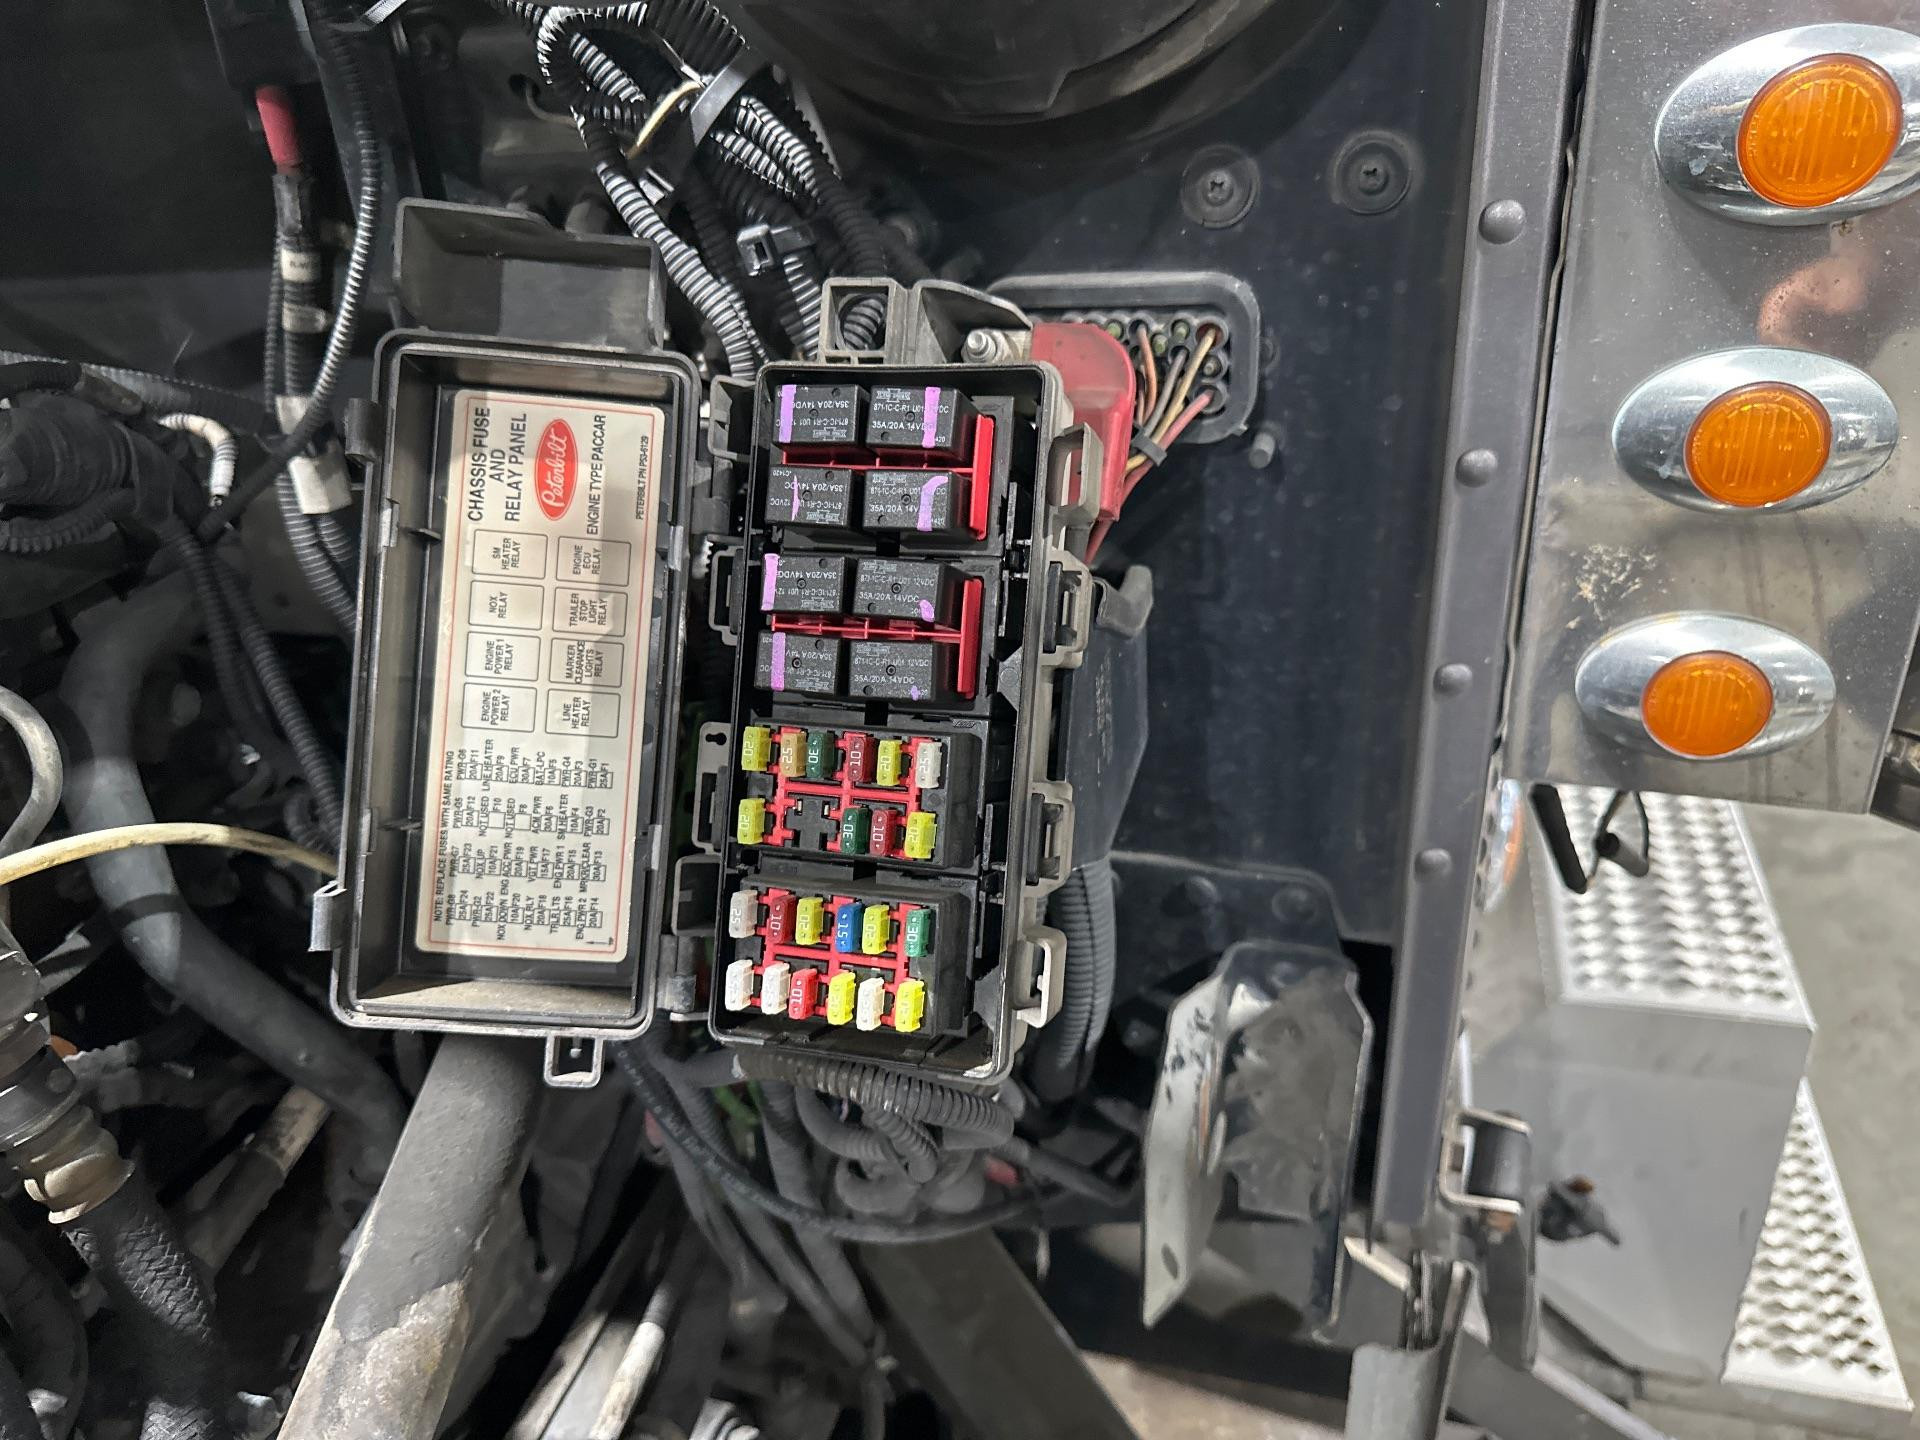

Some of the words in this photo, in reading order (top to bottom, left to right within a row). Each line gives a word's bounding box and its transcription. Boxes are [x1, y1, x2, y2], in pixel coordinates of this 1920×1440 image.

[473, 408, 490, 448] FUSE
[509, 413, 526, 465] PANEL
[592, 415, 605, 461] PACCAR
[489, 449, 505, 483] AND
[541, 428, 567, 506] Peterbilt
[590, 464, 602, 491] TYPE
[468, 453, 487, 521] CHASSIS
[505, 469, 523, 521] RELAY
[587, 494, 600, 535] ENGINE
[493, 547, 501, 559] SM
[502, 538, 512, 570] HEATER
[511, 541, 521, 568] RELAY
[573, 545, 583, 575] ENGINE
[583, 552, 592, 569] ECU
[592, 548, 601, 575] RELAY
[489, 596, 498, 613] NOX
[498, 592, 508, 619] RELAY
[569, 593, 579, 626] TRAILER
[579, 600, 587, 621] STOP
[588, 600, 598, 623] LIGHT
[598, 598, 608, 625] RELAY
[485, 641, 495, 671] ENGINE
[494, 644, 504, 674] POWER
[504, 643, 513, 670] RELAY
[566, 645, 576, 678] MARKER
[575, 640, 585, 684] CLEARANCE
[585, 649, 594, 677] LIGHTS
[594, 650, 604, 677] RELAY
[481, 692, 491, 721] ENGINE
[491, 695, 500, 725] POWER
[500, 694, 510, 721] RELAY
[563, 704, 571, 721] LINE
[571, 697, 581, 729] HEATER
[581, 700, 591, 726] RELAY
[470, 750, 479, 763] F11
[484, 739, 493, 771] HEATER
[496, 755, 505, 765] F9
[510, 747, 520, 766] PWR
[522, 757, 531, 767] F7
[548, 759, 557, 768] F5
[444, 751, 454, 781] RATING
[456, 749, 466, 780] PWR-G6
[469, 764, 478, 779] 20A
[535, 752, 546, 786] BAT-LPC
[562, 756, 571, 787] PWR-G4
[575, 760, 583, 770] F3
[601, 763, 609, 772] F1
[482, 773, 491, 791] LINE
[495, 766, 504, 781] 20A
[509, 768, 518, 783] ECU
[521, 768, 530, 783] 30A
[547, 769, 556, 783] 10A
[573, 771, 583, 786] 20A
[588, 758, 597, 789] PWR-G1
[599, 773, 608, 788] 25A
[443, 783, 452, 806] SAME
[467, 796, 475, 809] F12
[453, 797, 463, 829] PWR-G5
[480, 796, 489, 818] USED
[492, 798, 501, 811] F10
[506, 798, 515, 819] USED
[519, 804, 527, 814] F8
[533, 796, 542, 814] PWR
[545, 806, 553, 815] F6
[559, 794, 569, 826] HEATER
[571, 807, 580, 817] F4
[441, 808, 450, 828] WITH
[465, 810, 474, 825] 20A
[584, 806, 594, 837] PWR-G3
[597, 809, 606, 818] F2
[479, 818, 487, 837] NOT
[505, 821, 514, 838] NOT
[532, 816, 541, 834] ACM
[543, 816, 552, 831] 30A
[569, 818, 578, 832] 10A
[595, 820, 605, 834] 20A
[439, 830, 448, 856] FUSES
[558, 829, 566, 840] SM
[463, 843, 472, 857] F23
[477, 849, 485, 859] UP
[490, 845, 498, 859] F21
[503, 842, 512, 860] PWR
[515, 846, 524, 860] F19
[529, 846, 538, 864] PWR
[542, 848, 550, 861] F17
[568, 849, 577, 863] F15
[594, 851, 603, 865] F13
[449, 846, 459, 877] PWR-G7
[462, 859, 471, 873] 25A
[488, 860, 497, 874] 10A
[502, 861, 511, 878] ACC
[514, 862, 523, 876] 20A
[555, 852, 564, 870] PWR
[436, 858, 446, 895] REPLACE
[476, 861, 485, 879] NOX
[528, 865, 537, 882] VGT
[540, 864, 550, 877] 15A
[567, 865, 576, 878] 20A
[593, 866, 602, 881] 30A
[501, 879, 510, 895] ENG
[554, 872, 563, 888] ENG
[460, 890, 469, 904] F24
[486, 891, 494, 905] F22
[512, 893, 521, 907] F20
[525, 896, 534, 912] RLY
[538, 895, 547, 908] F18
[552, 896, 561, 911] LTS
[564, 896, 573, 910] F16
[590, 897, 599, 912] F14
[434, 897, 444, 921] NOTE:
[445, 894, 456, 925] PWR-G8
[459, 905, 468, 919] 25A
[472, 896, 482, 927] PWR-G2
[485, 907, 494, 921] 25A
[498, 899, 508, 923] DOWN
[511, 909, 520, 922] 10A
[537, 910, 546, 924] 20A
[578, 904, 587, 921] PWR
[524, 914, 533, 930] NOX
[551, 913, 560, 933] TRLR
[563, 911, 572, 926] 25A
[589, 913, 598, 927] 20A
[497, 924, 506, 940] NOX
[576, 923, 586, 939] ENG
